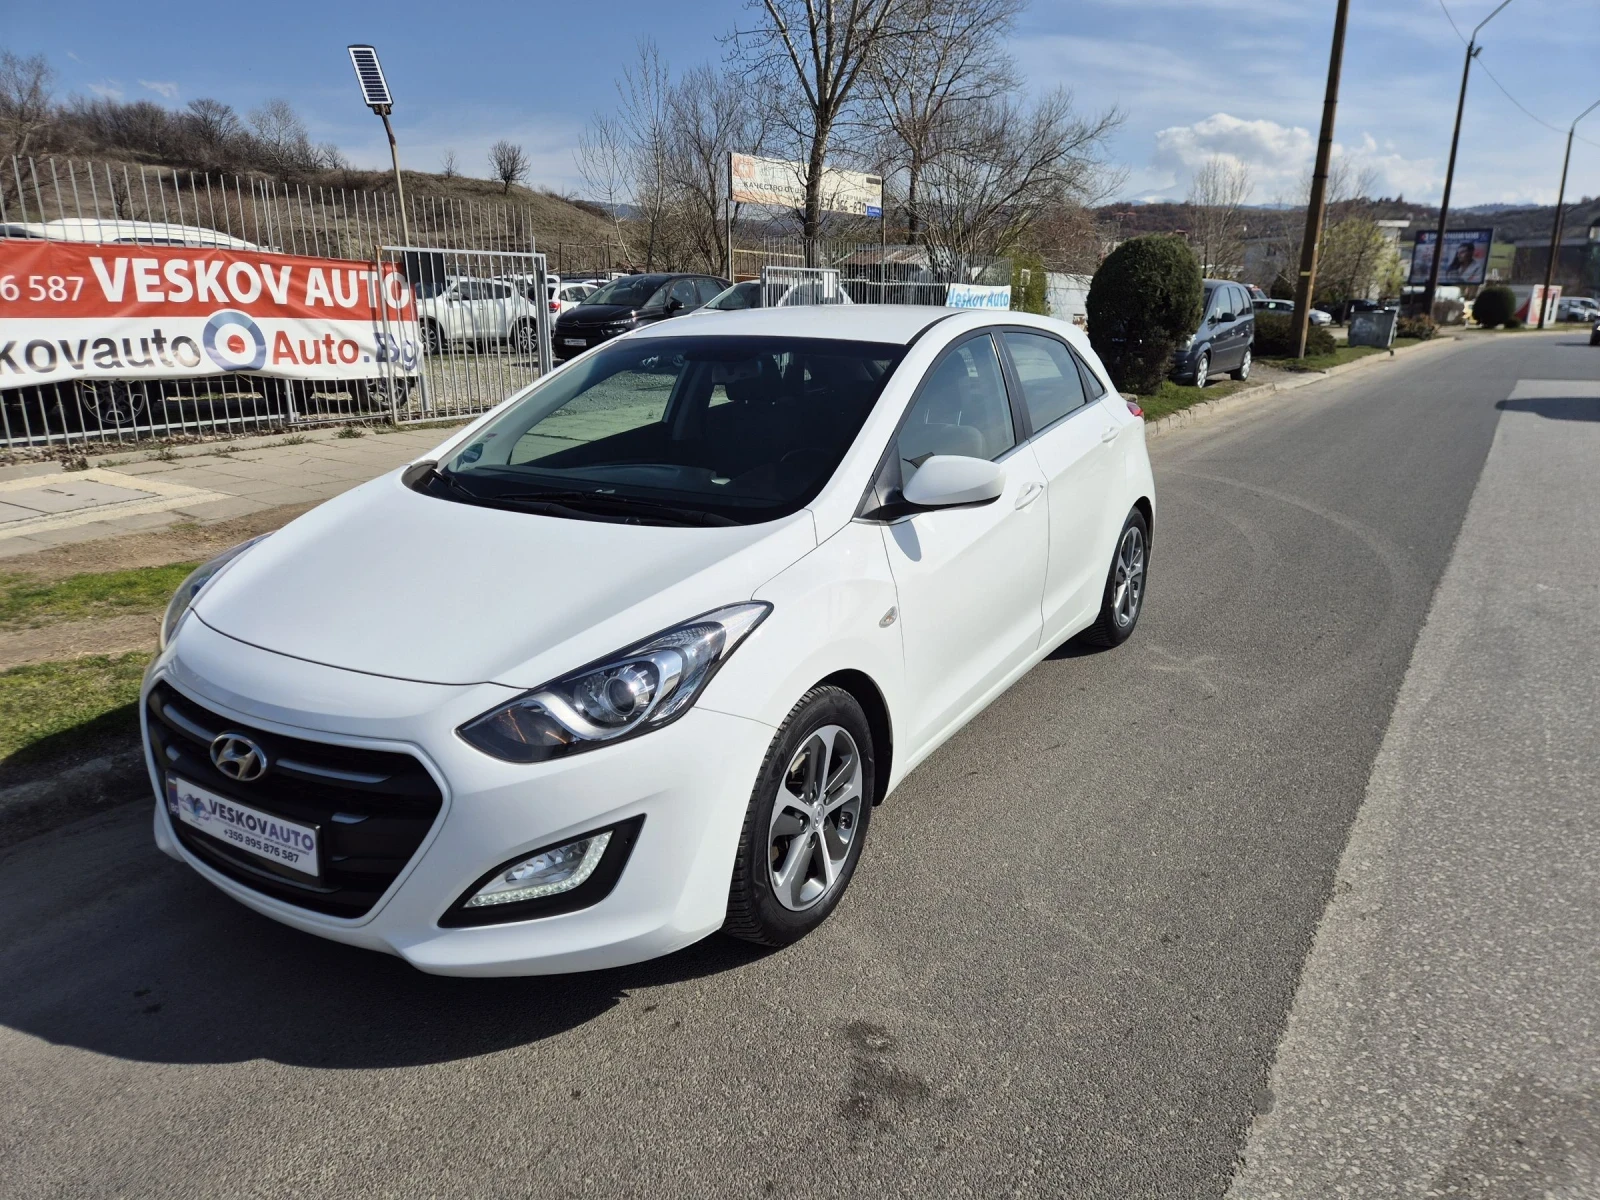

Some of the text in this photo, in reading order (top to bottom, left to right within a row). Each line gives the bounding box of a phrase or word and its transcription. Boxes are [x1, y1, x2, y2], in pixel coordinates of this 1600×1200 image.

[0, 256, 410, 310] 6 587 VESKOV AUTO
[986, 290, 1009, 307] Auto
[208, 798, 314, 851] VESKOVAUTO
[223, 829, 300, 863] +359 895 876 587
